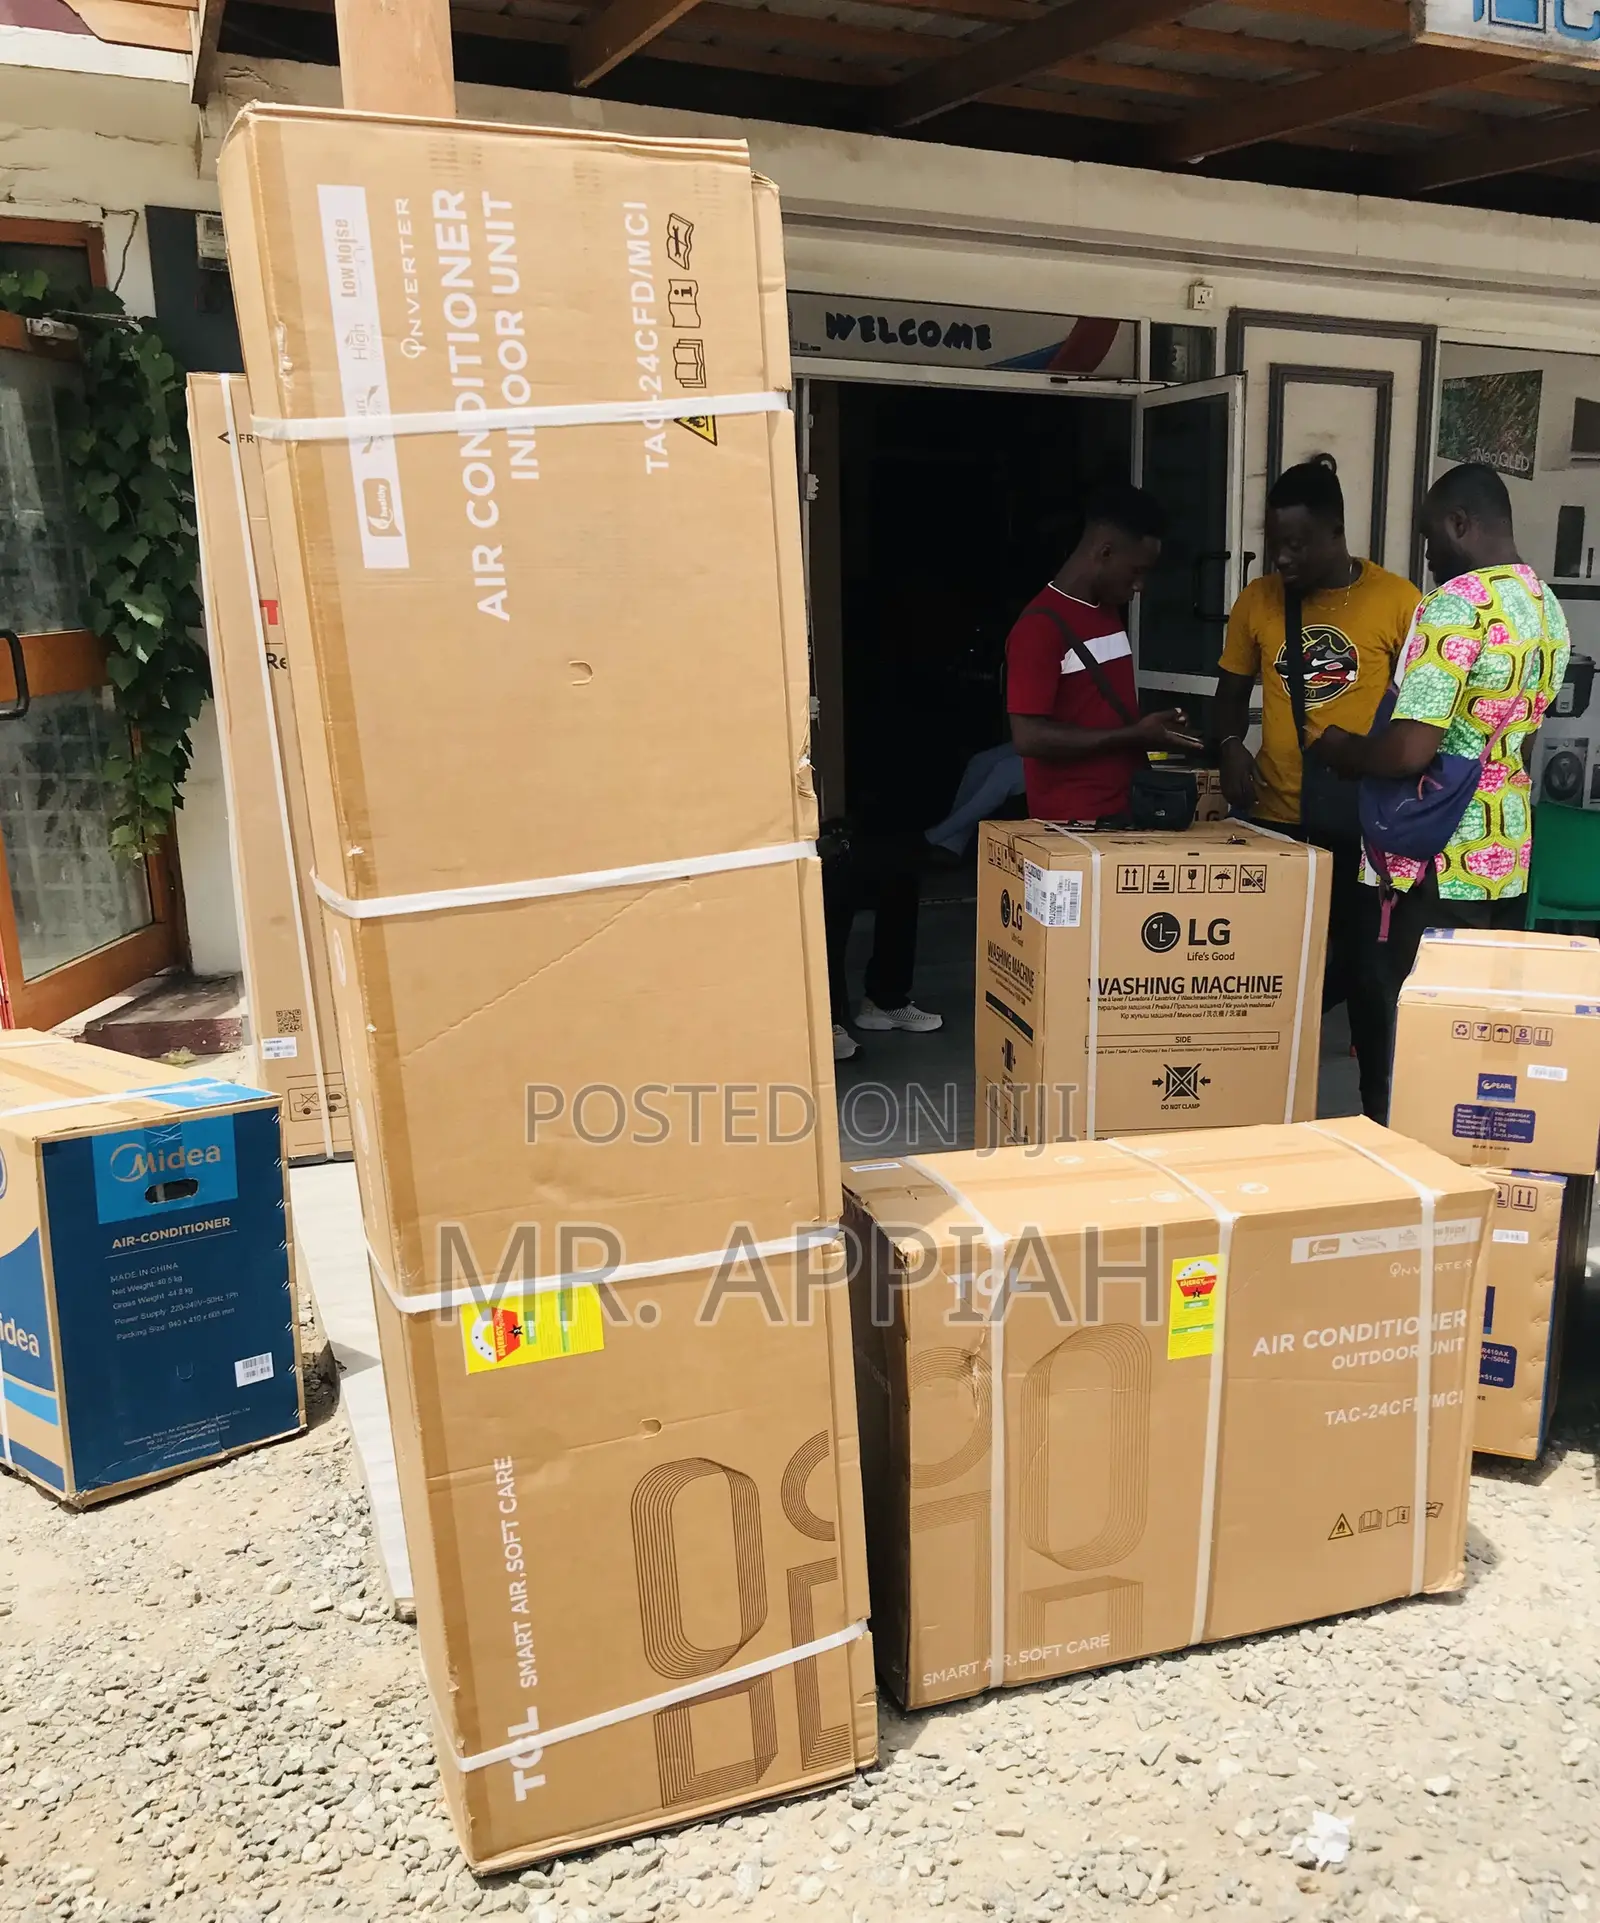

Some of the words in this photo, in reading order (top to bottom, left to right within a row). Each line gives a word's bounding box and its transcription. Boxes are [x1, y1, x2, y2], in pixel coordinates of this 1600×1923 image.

[481, 190, 520, 295] UNIT
[824, 311, 993, 351] WELCOME
[495, 309, 540, 480] INOOR
[1499, 451, 1530, 472] QLED
[471, 544, 511, 623] AIR
[1012, 899, 1023, 932] LG
[1187, 917, 1231, 946] LG
[987, 939, 1011, 971] WASHING
[1012, 953, 1035, 989] MACHINE
[1187, 951, 1210, 962] Life's
[1211, 951, 1235, 962] Good
[1191, 975, 1284, 995] MACHINE
[1175, 1035, 1192, 1044] SIDE
[1491, 1081, 1513, 1091] PEARL
[110, 1143, 222, 1182] Midea
[112, 1216, 231, 1250] AIR-CONDITIONER
[109, 1270, 138, 1283] MADE
[138, 1268, 149, 1277] IN
[150, 1262, 179, 1274] CHINA
[111, 1287, 126, 1296] Net
[173, 1275, 183, 1284] kg
[947, 1266, 1033, 1300] TCL
[1252, 1333, 1295, 1358] AIR
[1331, 1346, 1418, 1371] OUTDOOR
[493, 1455, 518, 1515] CARE
[513, 1620, 539, 1689] SMART
[922, 1660, 980, 1688] SMART
[1066, 1633, 1111, 1655] CARE
[507, 1705, 547, 1802] TCL
